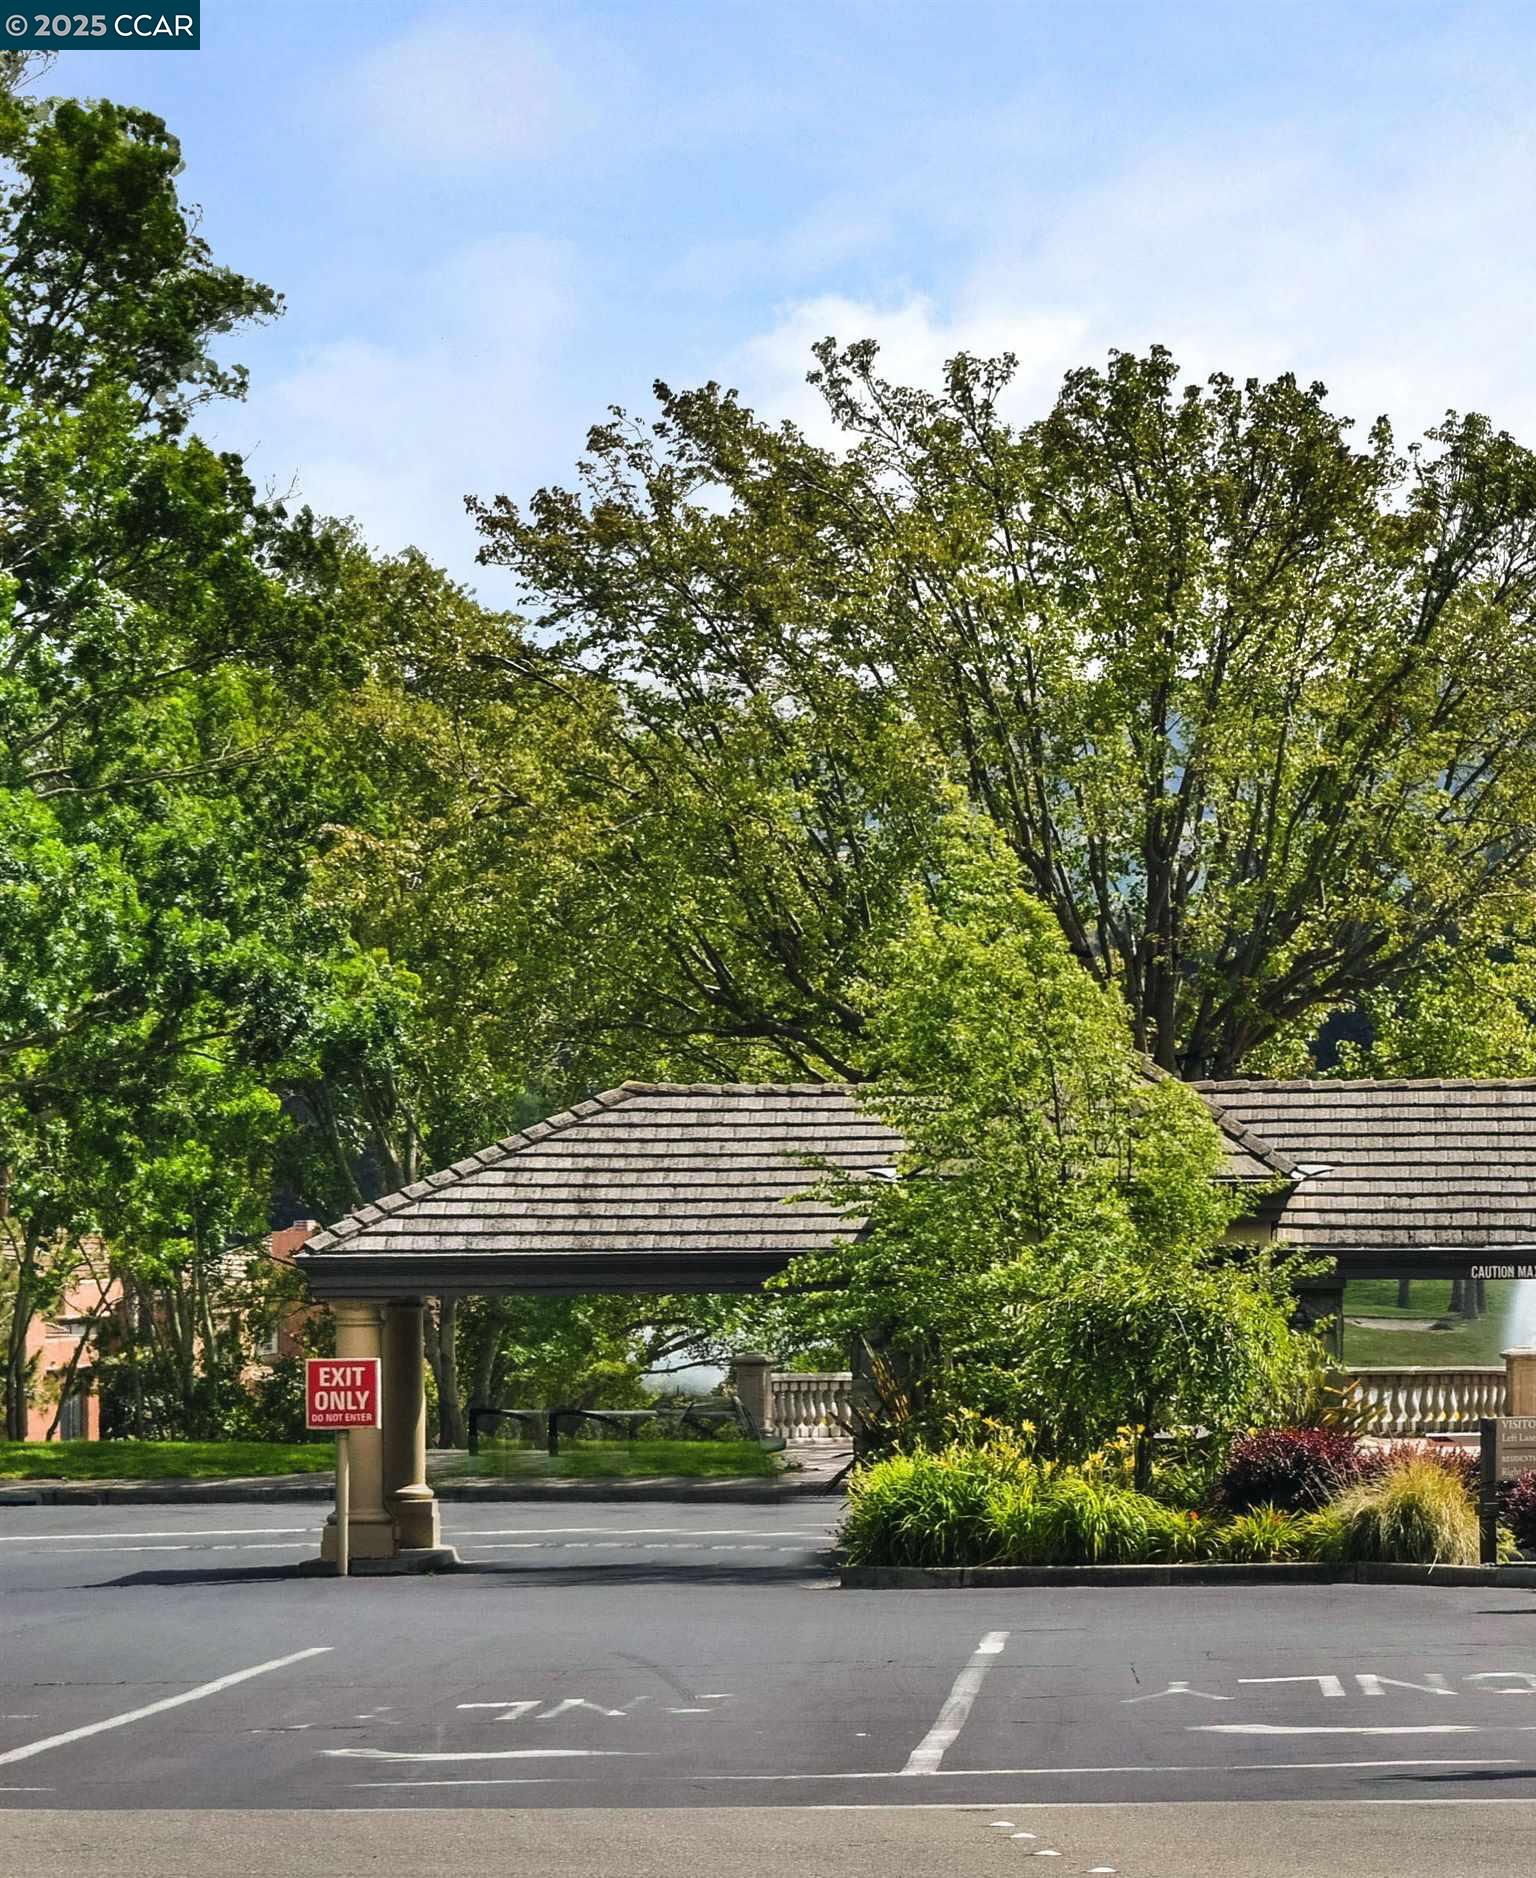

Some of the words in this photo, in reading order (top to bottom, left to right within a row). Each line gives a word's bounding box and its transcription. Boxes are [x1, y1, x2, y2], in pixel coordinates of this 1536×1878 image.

[1471, 1265, 1515, 1279] CAUTION
[319, 1367, 366, 1387] EXIT
[314, 1390, 370, 1411] ONLY
[311, 1414, 324, 1422] DO
[325, 1413, 344, 1422] NOT
[344, 1413, 373, 1422] ENTER
[1501, 1432, 1518, 1442] Left
